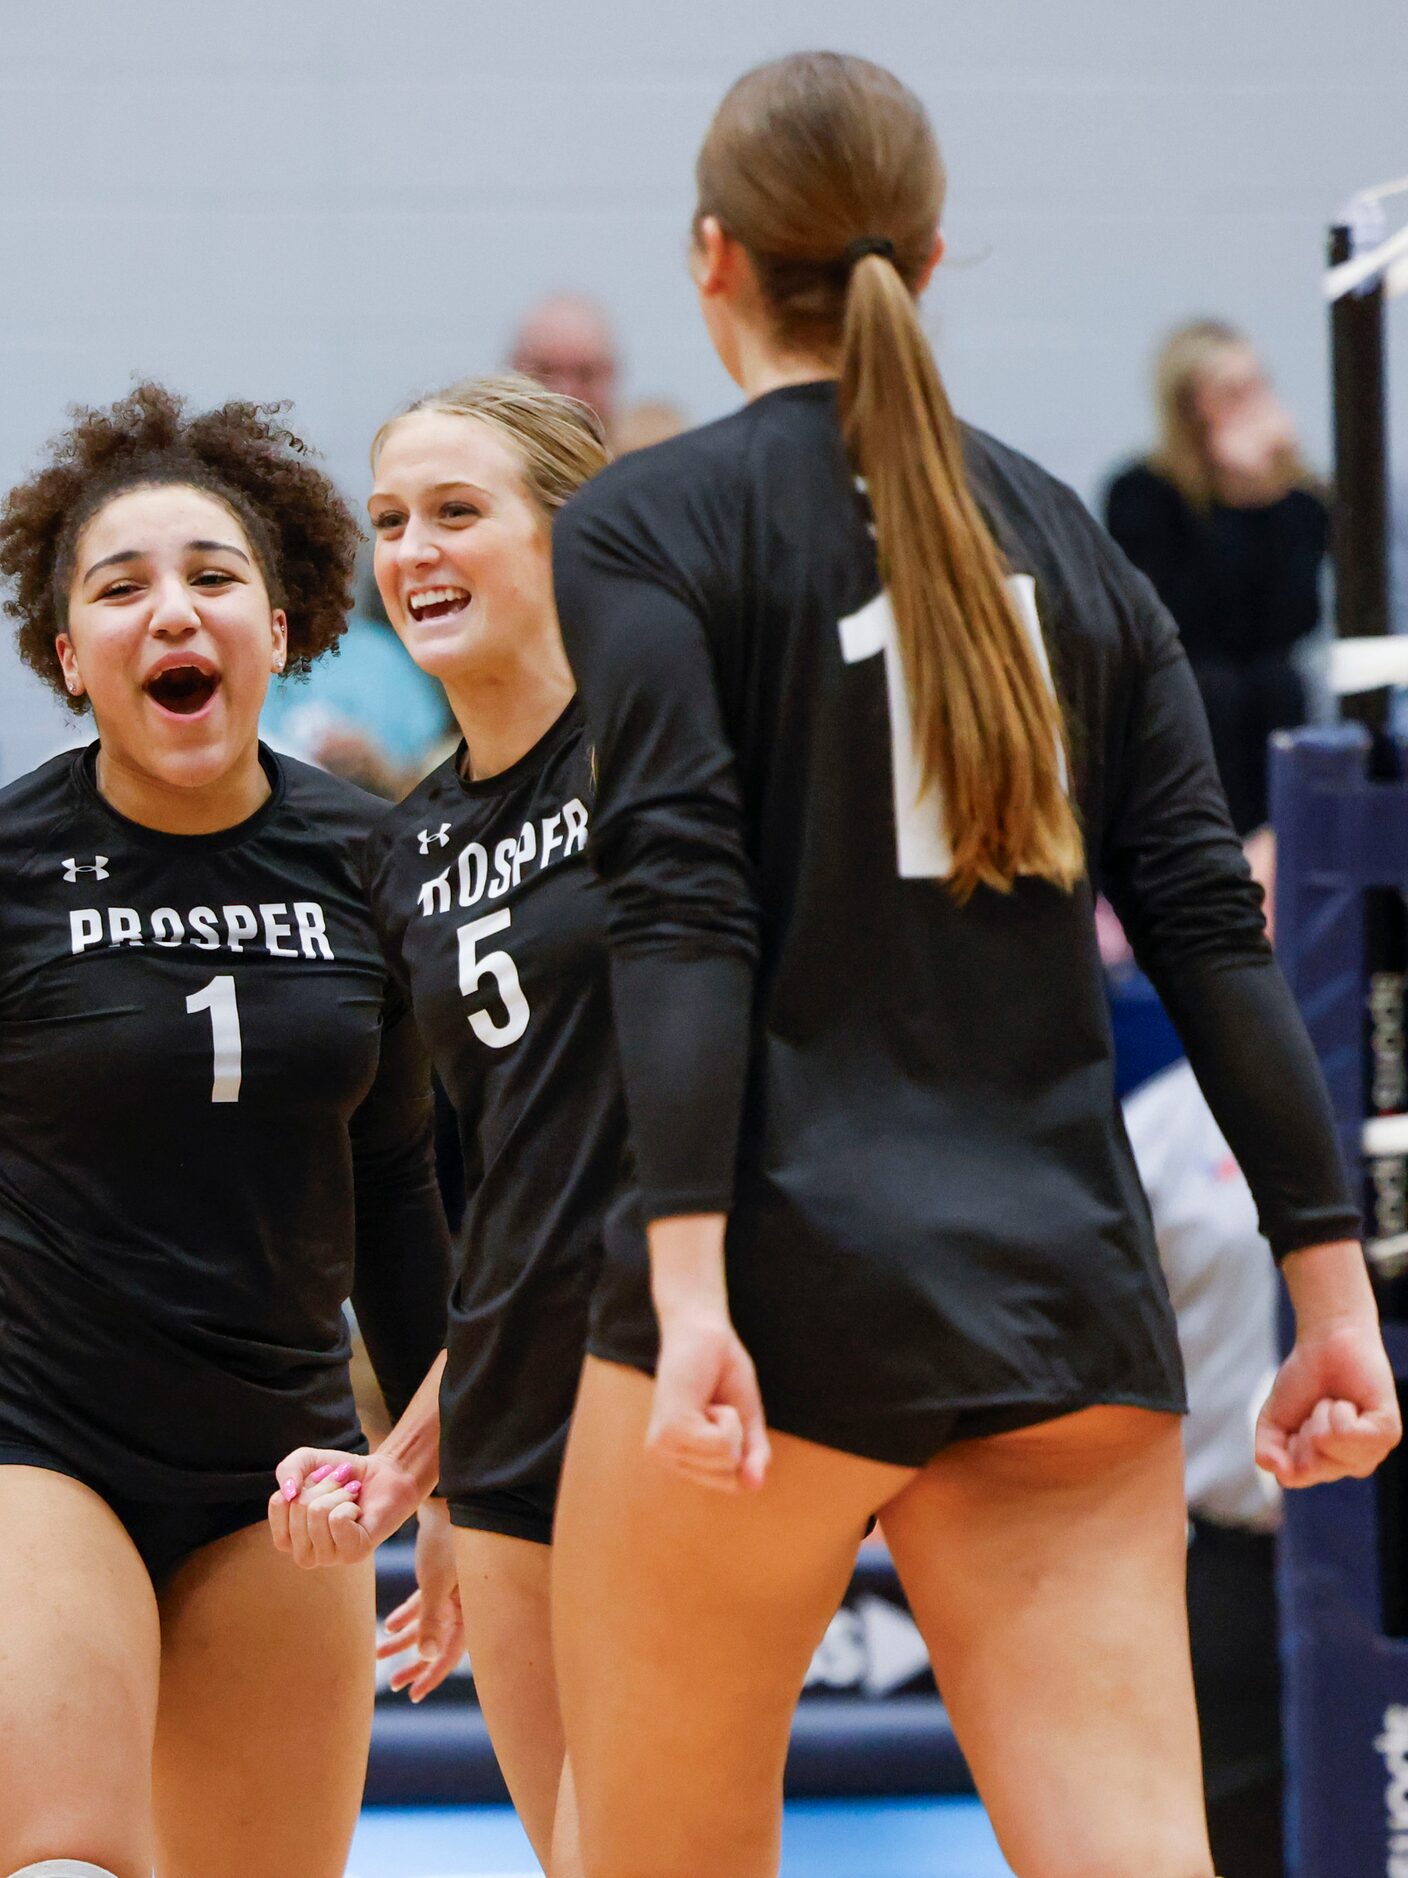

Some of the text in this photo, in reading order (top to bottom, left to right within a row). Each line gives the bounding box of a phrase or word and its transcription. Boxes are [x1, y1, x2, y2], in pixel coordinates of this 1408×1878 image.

[417, 798, 589, 917] ROSPER
[69, 901, 335, 960] PROSPER
[456, 907, 531, 1049] 5
[185, 975, 242, 1103] 1
